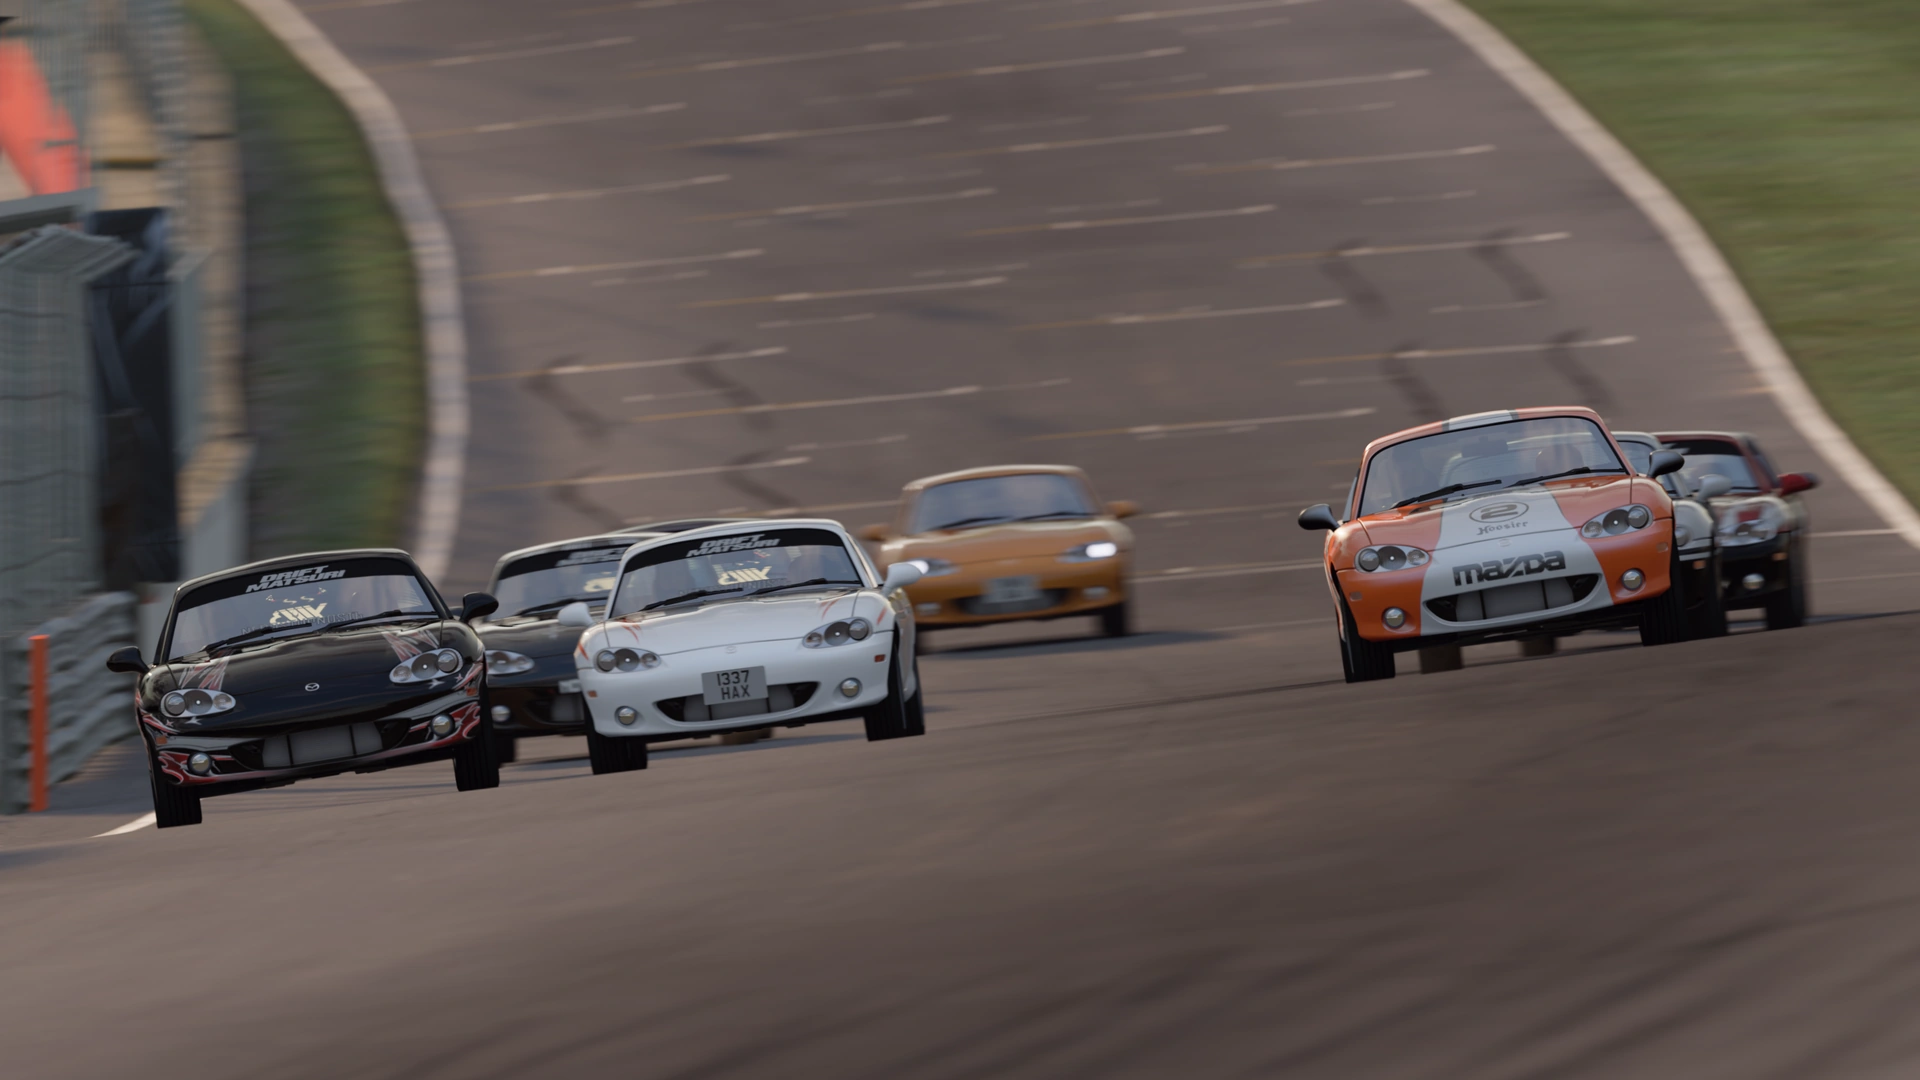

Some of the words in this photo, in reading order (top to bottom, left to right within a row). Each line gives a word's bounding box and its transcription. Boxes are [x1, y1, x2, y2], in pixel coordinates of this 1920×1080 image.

[1480, 504, 1519, 520] 2
[686, 539, 781, 557] MATSURI
[700, 533, 766, 549] DRIFT
[245, 570, 346, 593] MATSURI
[259, 565, 329, 583] DRIFT
[721, 685, 750, 700] HAX
